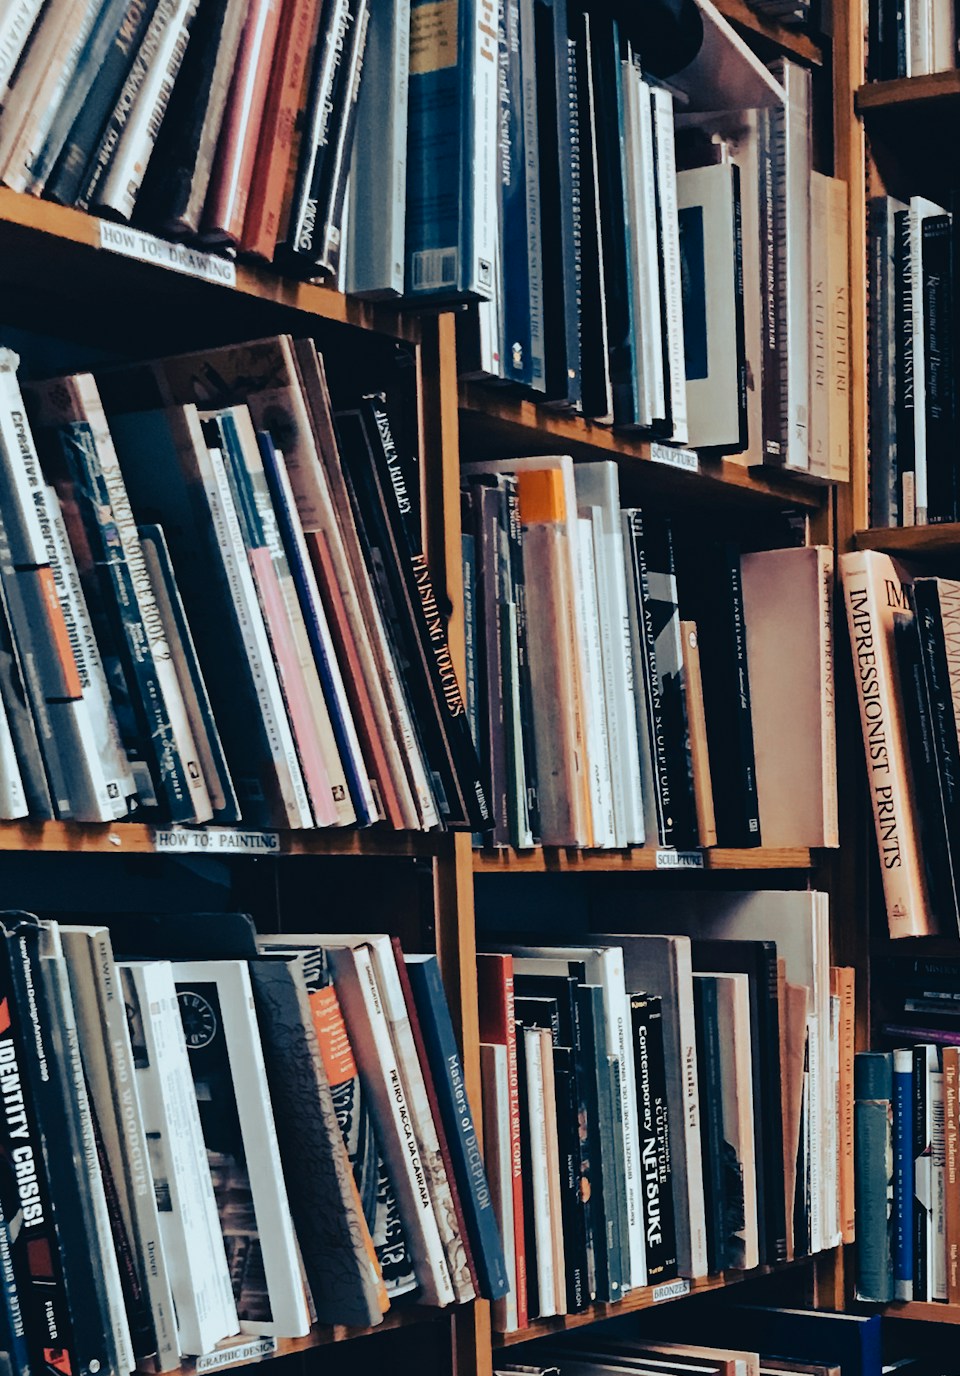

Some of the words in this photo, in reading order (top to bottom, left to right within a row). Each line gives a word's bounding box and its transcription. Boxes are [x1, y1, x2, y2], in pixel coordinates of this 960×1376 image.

[299, 199, 319, 250] VIKING
[103, 226, 135, 248] HOW
[139, 239, 162, 259] TO:
[169, 248, 232, 279] DRAWING
[375, 410, 402, 461] JESSICA
[652, 448, 696, 468] SCULPTURE
[387, 465, 412, 514] RIDLEY
[13, 411, 47, 487] Creative
[33, 492, 70, 589] Watercolor
[55, 594, 92, 689] Techniques
[103, 465, 137, 531] STENCIL
[122, 536, 153, 599] SOURCE
[138, 604, 165, 643] BOOK
[155, 652, 169, 662] 2
[410, 554, 444, 641] FINISHING
[432, 644, 465, 718] TOUCHES
[849, 589, 890, 773] IMPRESSIONIST
[875, 787, 902, 869] PRINTS
[159, 833, 188, 848] HOW
[193, 835, 214, 848] TO:
[219, 835, 277, 849] PAINTING
[657, 852, 703, 868] SCULPTURE
[506, 978, 513, 988] IL
[505, 992, 516, 1034] MARCO
[507, 1036, 518, 1085] AURELIO
[639, 1026, 652, 1131] Contemporary
[947, 1065, 956, 1084] The
[0, 1039, 28, 1138] IDENTITY
[390, 1070, 403, 1104] PIETRO
[447, 1055, 466, 1114] Masters
[511, 1088, 519, 1097] E
[947, 1086, 956, 1117] Advent
[399, 1106, 411, 1138] TACCA
[461, 1118, 473, 1132] of
[511, 1099, 519, 1114] LA
[948, 1121, 957, 1129] of
[511, 1118, 520, 1139] SUA
[407, 1142, 416, 1156] DA
[512, 1144, 521, 1177] COPIA
[948, 1132, 957, 1183] Modernism
[11, 1145, 44, 1228] CRISIS!
[409, 1159, 429, 1208] CARRARA
[465, 1136, 491, 1209] DECEPTION
[642, 1138, 661, 1247] NETSUKE
[574, 1269, 582, 1307] HYPERION
[654, 1283, 688, 1299] BRONZES
[45, 1301, 58, 1339] FISHER
[198, 1348, 241, 1369] GRAPHIC
[242, 1341, 274, 1360] DESIGN
